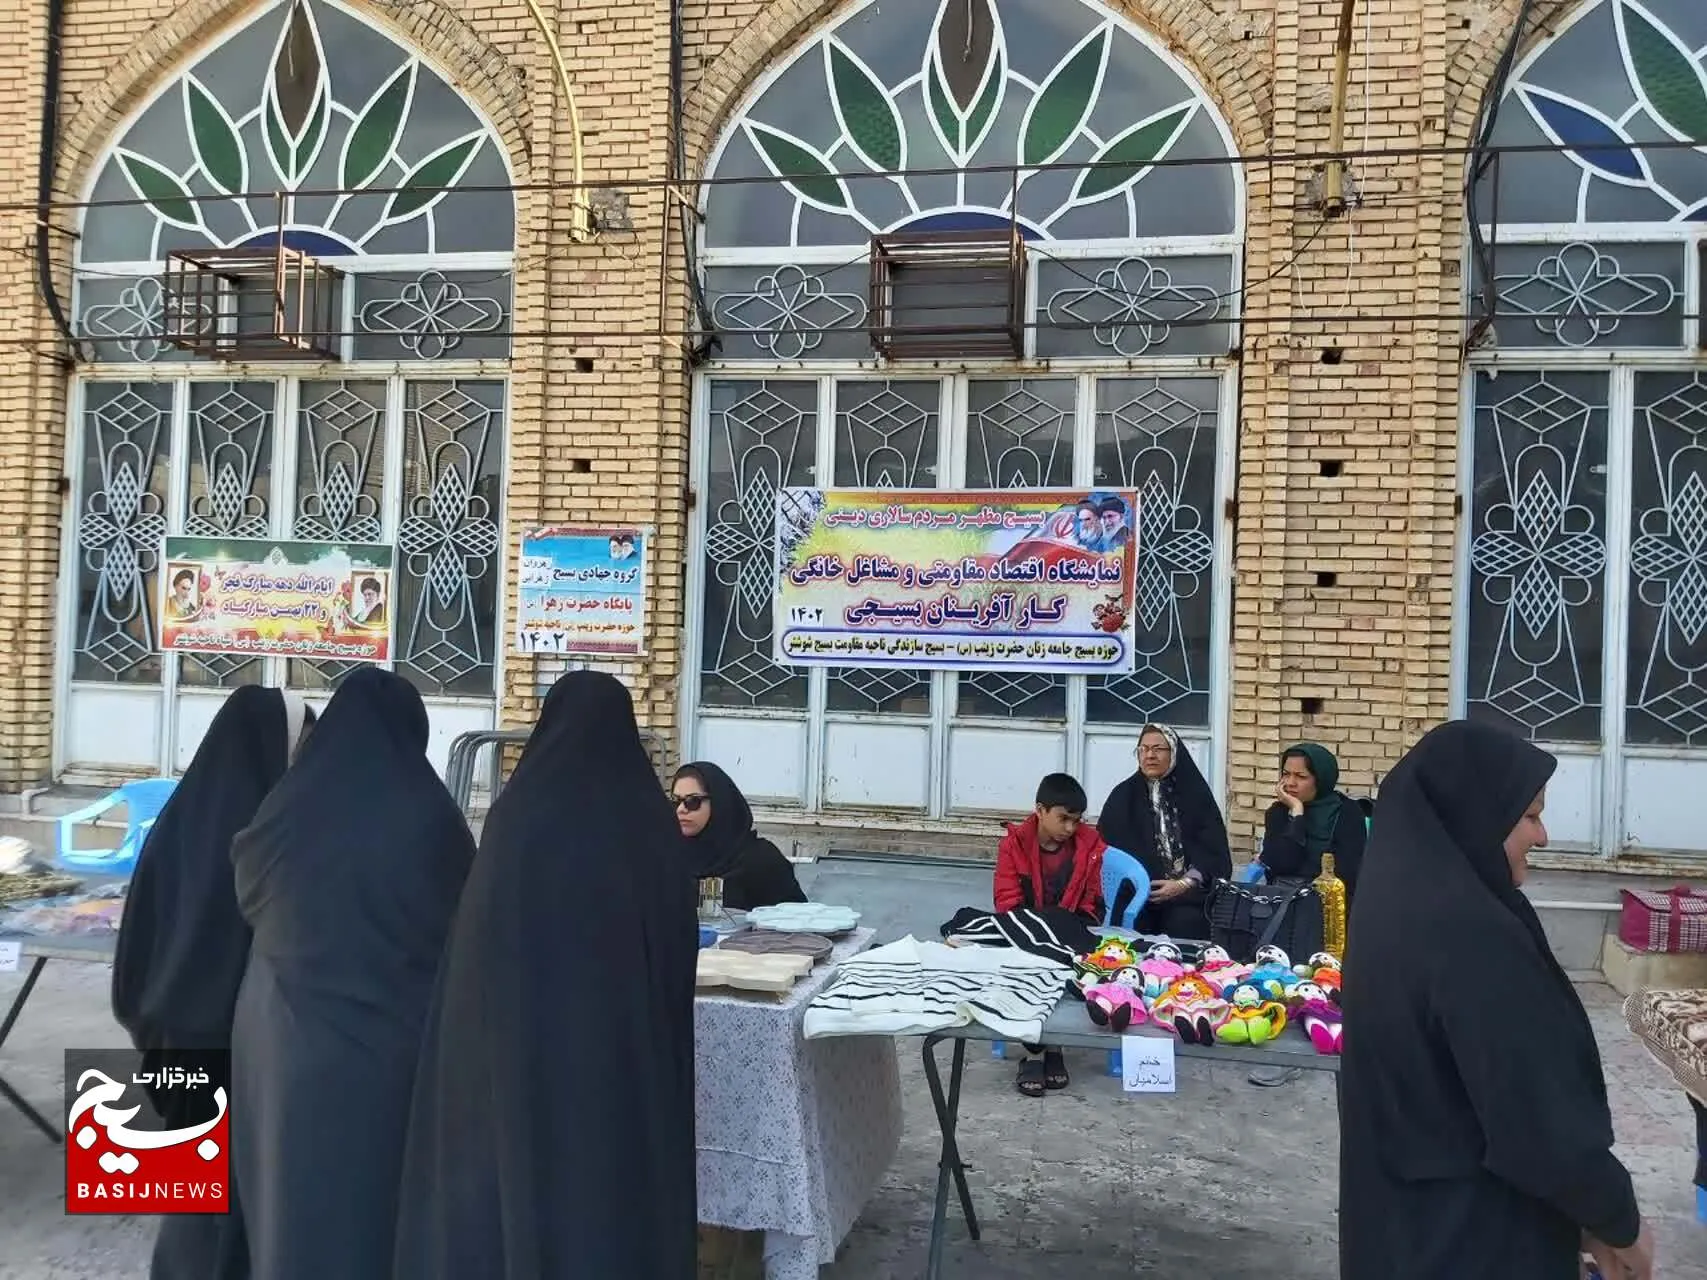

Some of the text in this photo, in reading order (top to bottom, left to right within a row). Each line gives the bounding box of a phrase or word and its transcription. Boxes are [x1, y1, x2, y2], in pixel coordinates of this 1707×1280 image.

[825, 508, 865, 527] دینی
[957, 507, 1001, 528] مظهر
[1003, 511, 1045, 528] بسیج
[553, 566, 638, 583] گروه جهادی بسیج
[791, 555, 1122, 588] نمایشگاه اقتصاد مقاومتی و مشاغل خانگی
[223, 576, 332, 594] ایام الله دهه مبارک فجر
[271, 604, 304, 617] بهمن
[541, 596, 563, 611] زهرا
[566, 596, 600, 612] حضرت
[604, 596, 632, 614] پایگاه
[846, 593, 1067, 629] کار آفرینان بسیجی
[319, 609, 327, 620] و
[791, 607, 824, 622] ۱۴۰۲
[520, 632, 564, 651] ۱۴۰۲
[788, 636, 813, 652] شوشتر
[814, 640, 832, 652] بسیج
[834, 637, 863, 654] مقاومت
[865, 637, 886, 654] ناحیه
[887, 638, 923, 655] سازندگی
[925, 642, 944, 655] بسیج
[974, 641, 995, 658] زینب
[997, 641, 1024, 658] حضرت
[1027, 641, 1045, 658] زنان
[1048, 642, 1072, 658] جامعه
[1074, 645, 1095, 658] بسیج
[1099, 643, 1118, 660] حوزه
